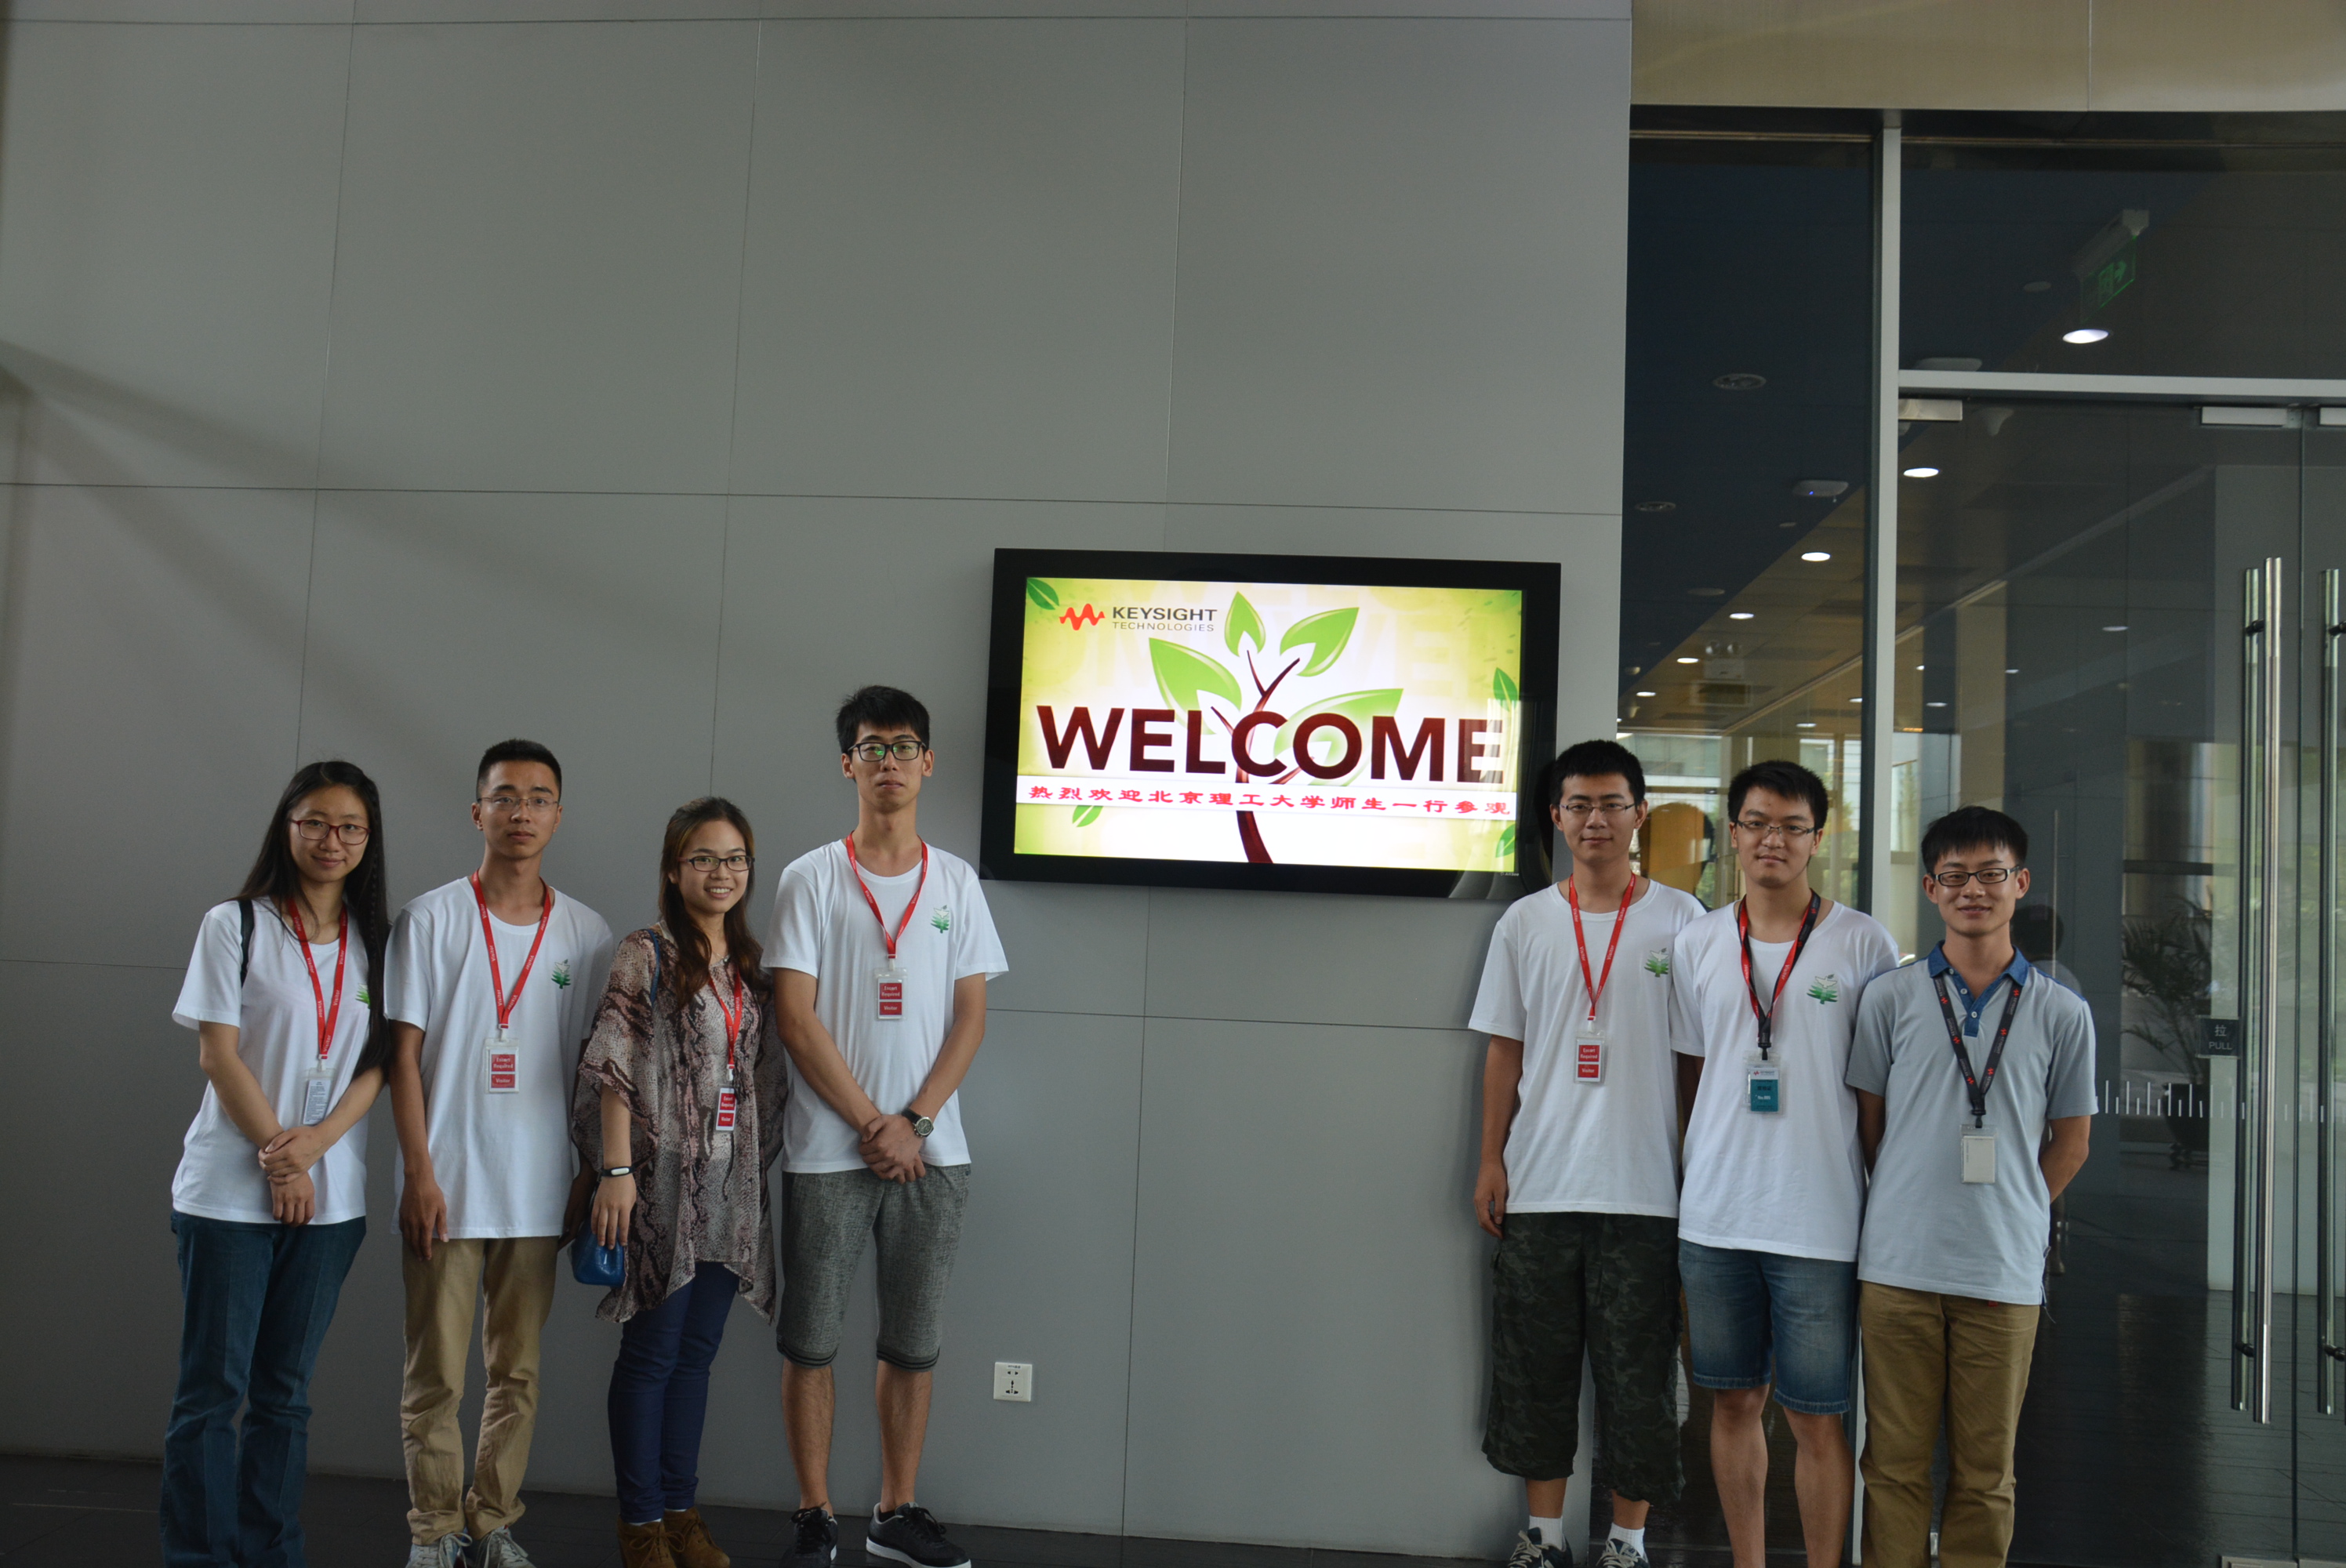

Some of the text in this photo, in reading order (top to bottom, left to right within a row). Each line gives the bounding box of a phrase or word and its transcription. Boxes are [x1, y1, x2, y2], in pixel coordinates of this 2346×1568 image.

[1113, 606, 1217, 621] KEYSIGHT
[1113, 622, 1215, 632] TECHNOLOGIES
[1037, 706, 1503, 784] WELCOME
[1029, 786, 1510, 815] 热烈欢迎北京理工大学师生一行参观
[508, 994, 518, 1010] Visitor
[2214, 1024, 2227, 1036] 拉
[2208, 1041, 2233, 1050] PULL
